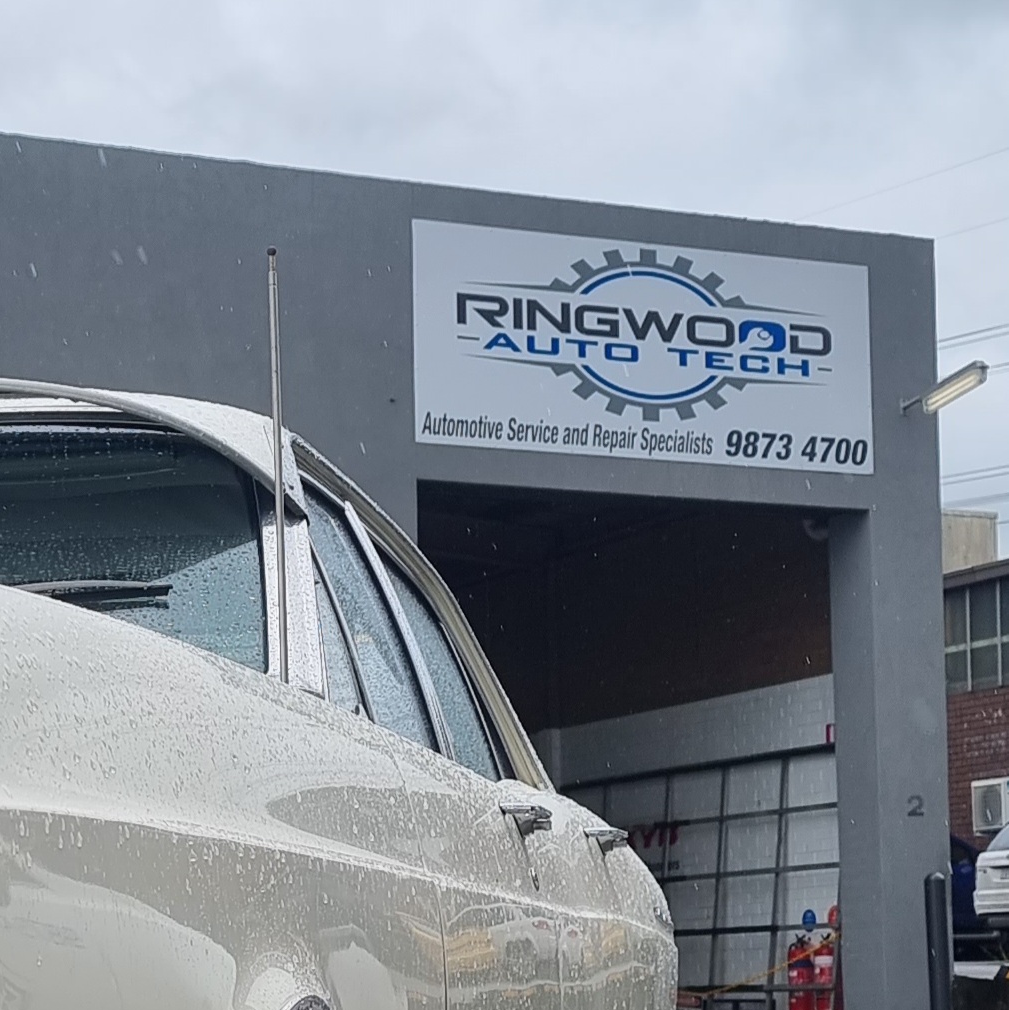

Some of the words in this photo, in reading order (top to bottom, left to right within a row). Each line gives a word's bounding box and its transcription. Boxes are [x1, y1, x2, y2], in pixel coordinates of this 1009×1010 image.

[456, 292, 832, 357] RINGWOOD
[483, 332, 640, 363] AUTO
[667, 347, 810, 377] TECH
[422, 411, 503, 440] Automotive
[507, 417, 559, 445] Service
[562, 423, 590, 447] and
[592, 423, 638, 453] Repair
[640, 427, 713, 456] Specialists
[725, 429, 793, 461] 9873
[801, 436, 868, 466] 4700
[907, 795, 924, 817] 2
